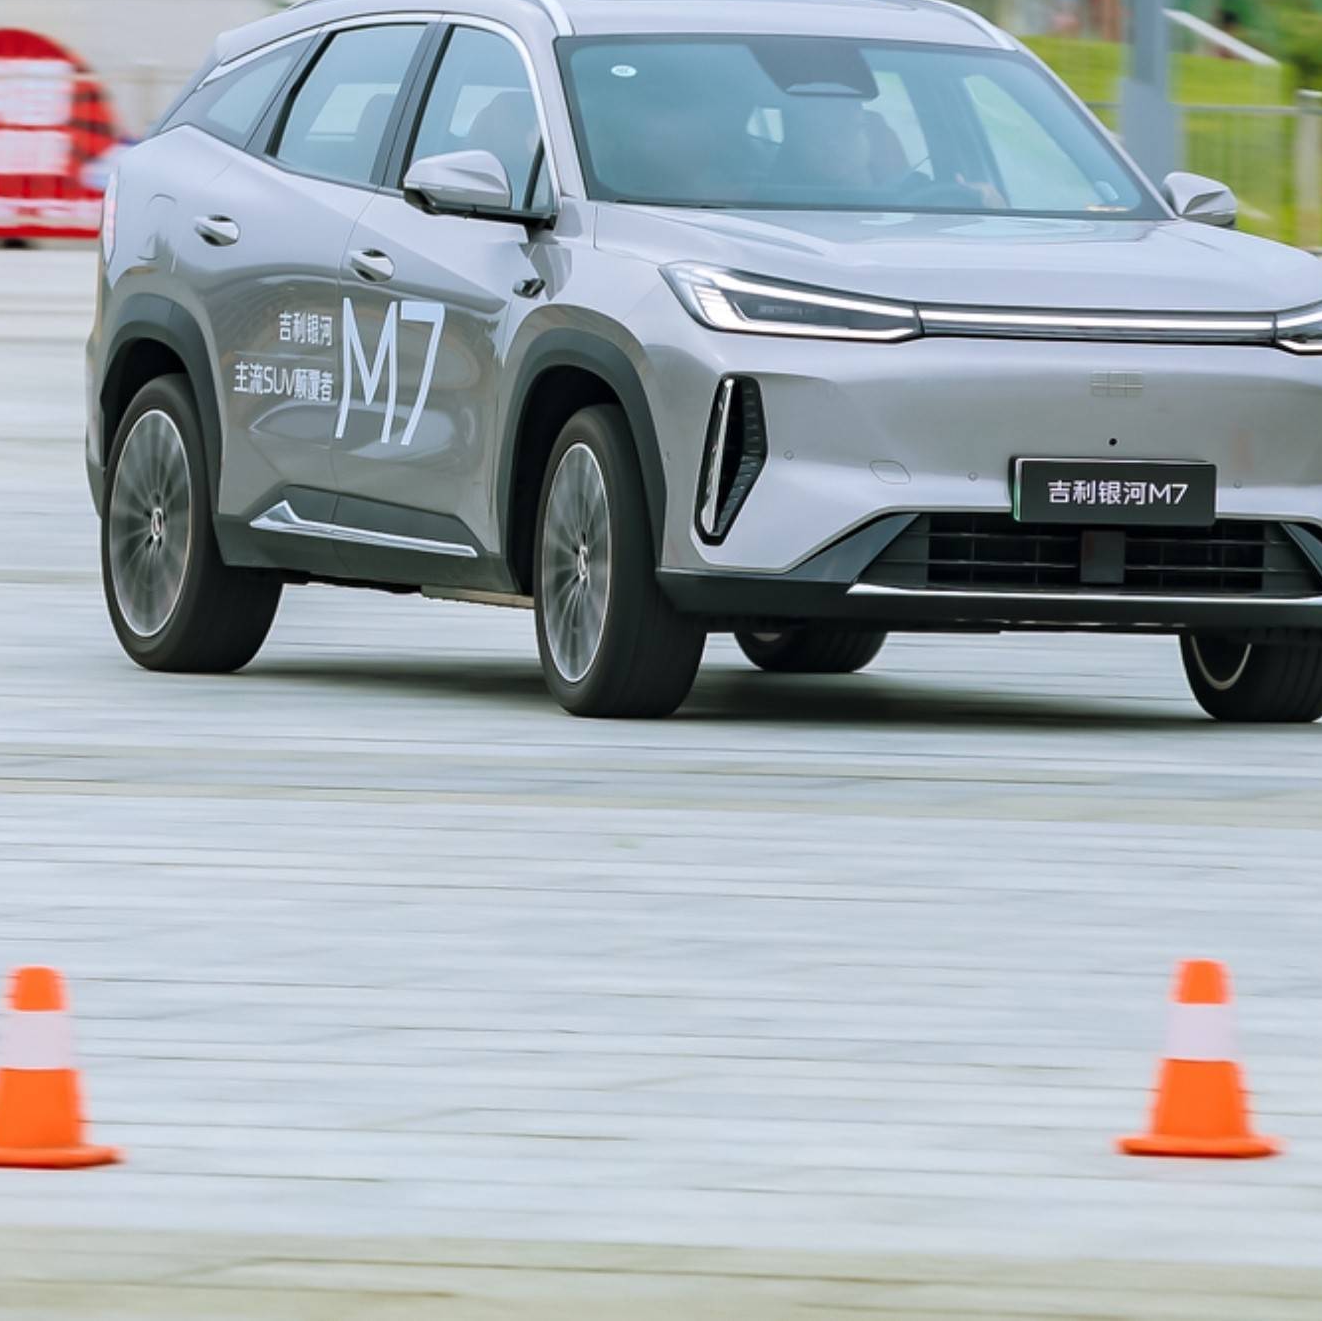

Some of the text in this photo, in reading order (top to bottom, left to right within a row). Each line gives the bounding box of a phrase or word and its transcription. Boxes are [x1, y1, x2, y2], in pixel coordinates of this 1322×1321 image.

[278, 311, 333, 347] 吉利银河
[334, 297, 445, 446] M7
[1047, 479, 1189, 506] 吉利银河M7
